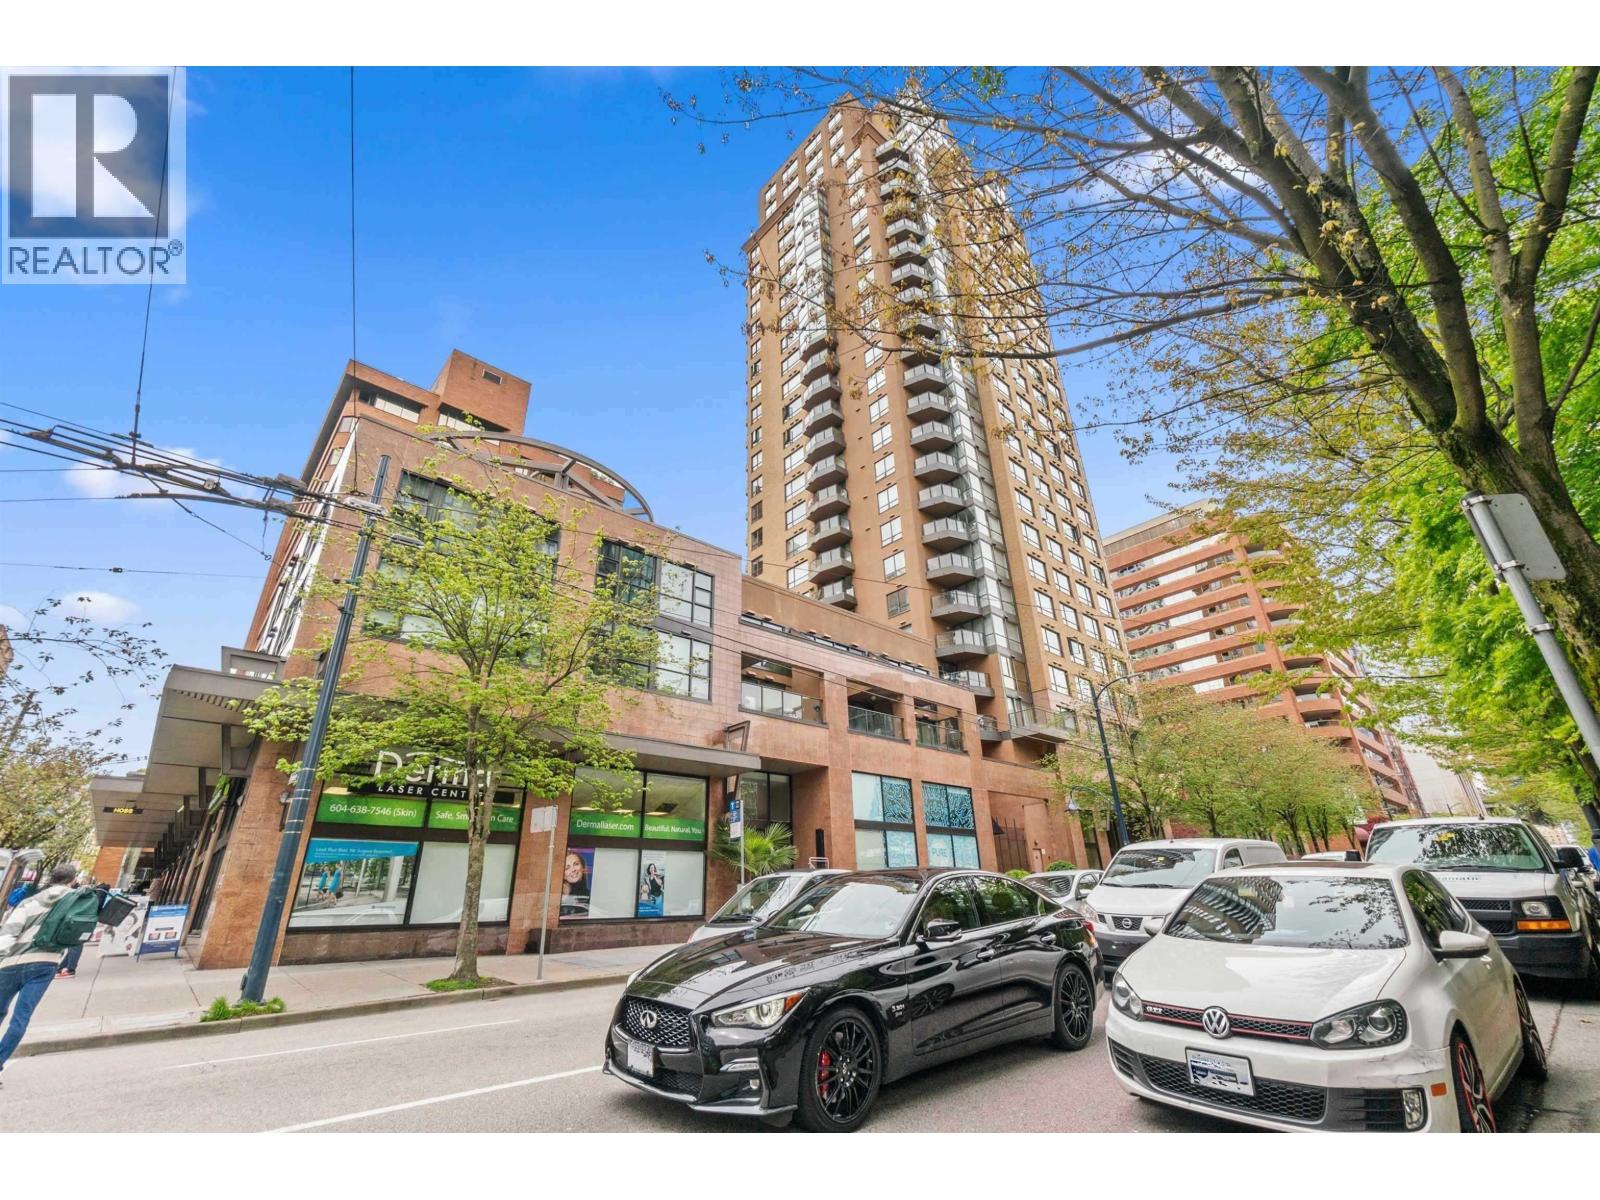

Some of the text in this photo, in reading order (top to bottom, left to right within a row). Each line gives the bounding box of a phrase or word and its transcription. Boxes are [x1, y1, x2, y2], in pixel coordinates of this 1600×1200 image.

[378, 784, 424, 795] LASER
[329, 804, 417, 818] 604-638-7546 (Skin)
[497, 813, 515, 823] Care
